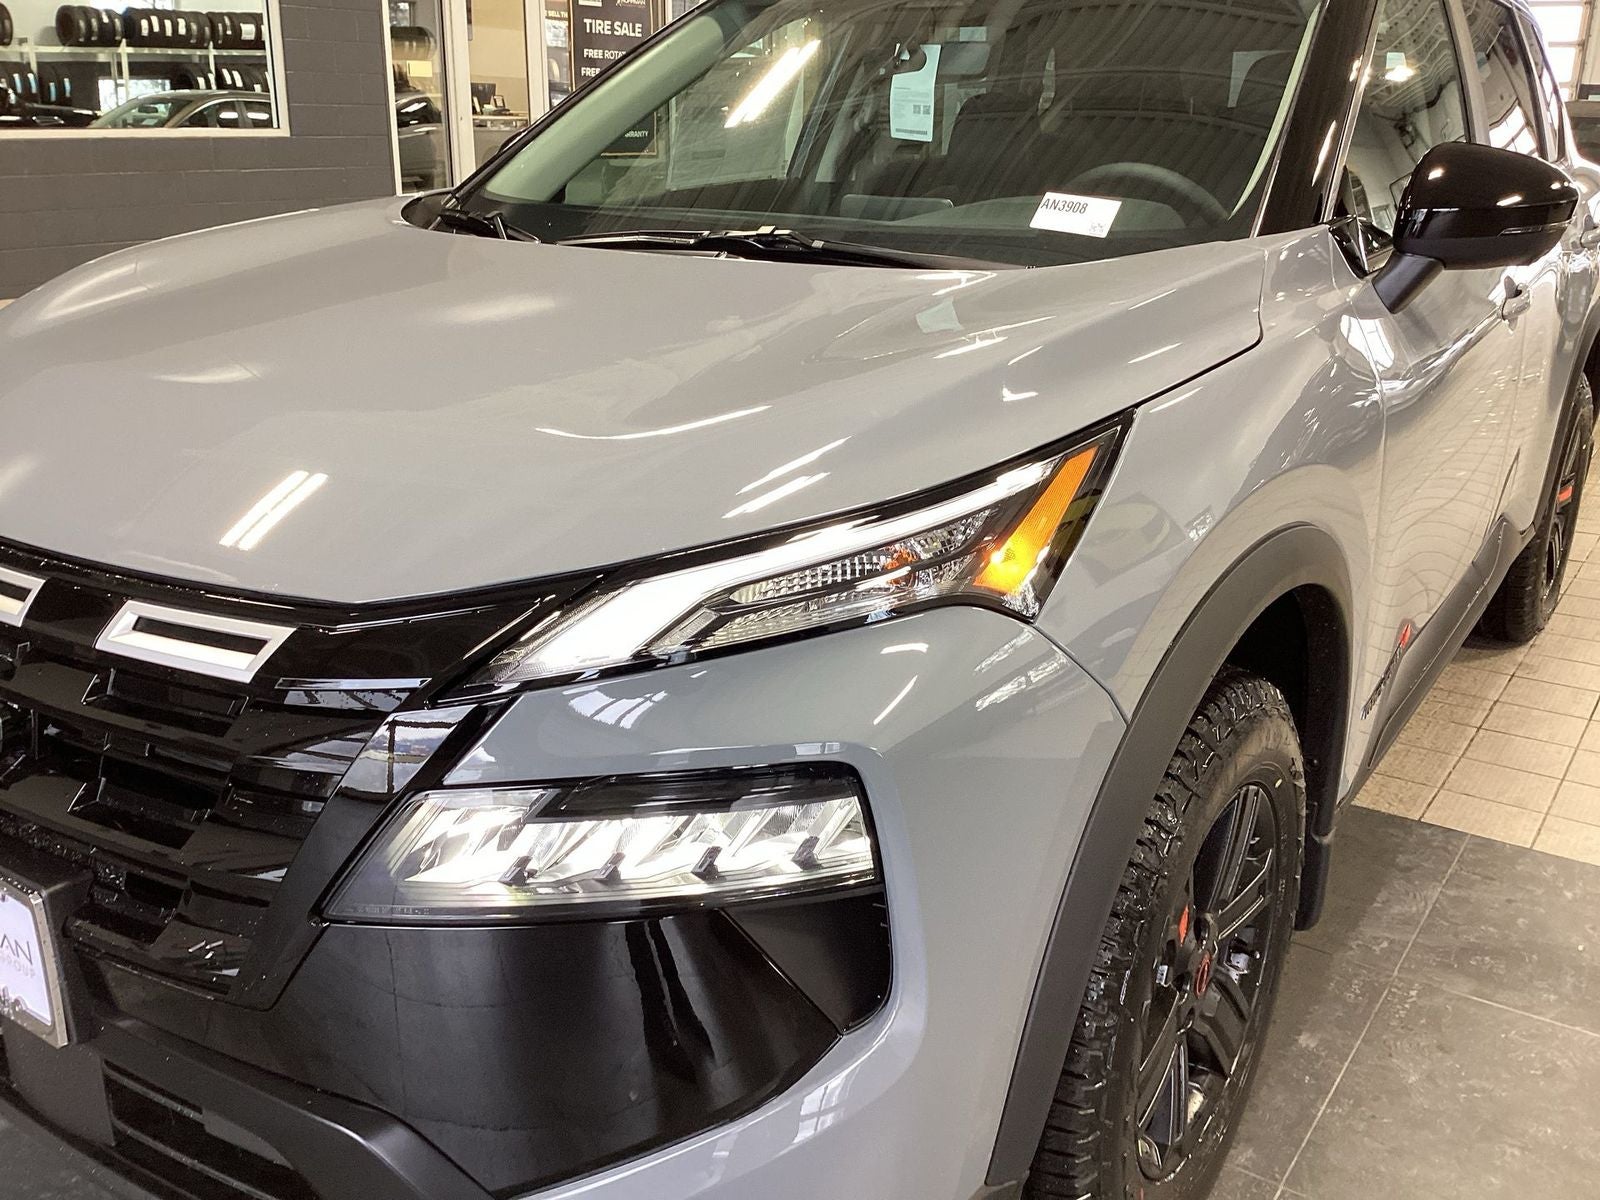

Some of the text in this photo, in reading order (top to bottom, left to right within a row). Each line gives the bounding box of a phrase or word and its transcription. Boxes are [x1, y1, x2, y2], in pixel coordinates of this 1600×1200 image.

[583, 18, 612, 35] TIRE
[613, 21, 643, 38] SALE
[583, 48, 603, 59] FREE
[1040, 198, 1089, 215] AN3908
